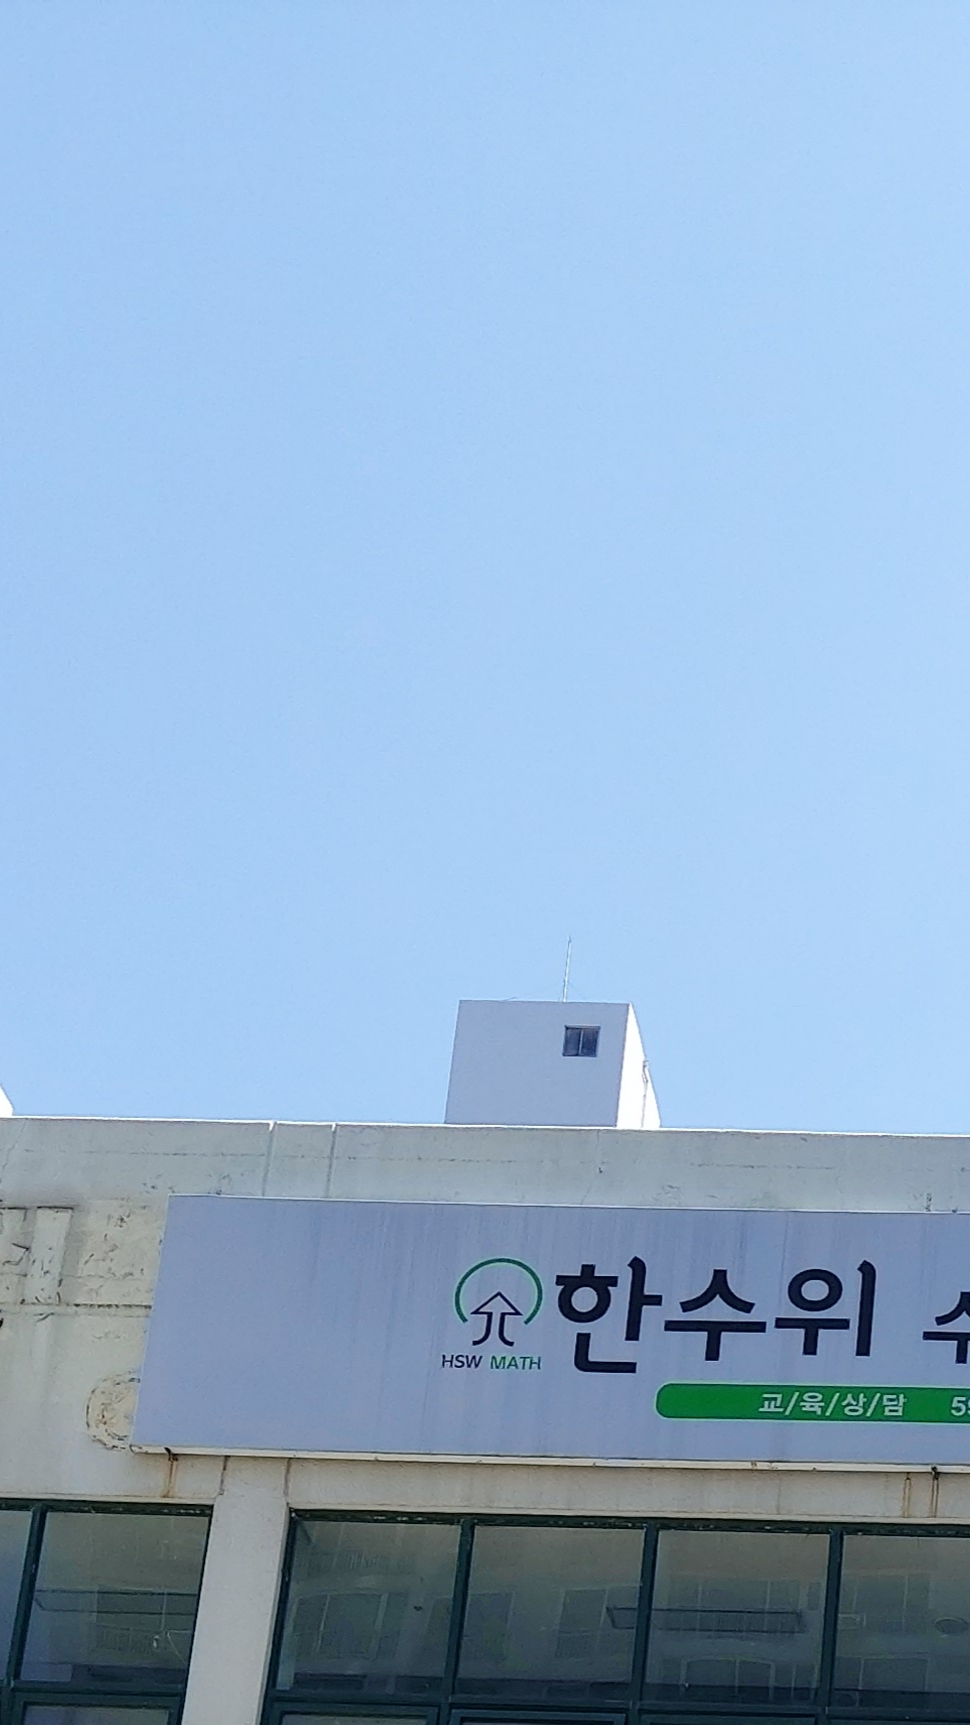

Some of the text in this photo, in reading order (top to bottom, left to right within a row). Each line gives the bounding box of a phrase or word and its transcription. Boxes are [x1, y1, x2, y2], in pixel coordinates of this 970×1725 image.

[555, 1256, 876, 1374] 한수위
[441, 1354, 542, 1370] HSW MATH
